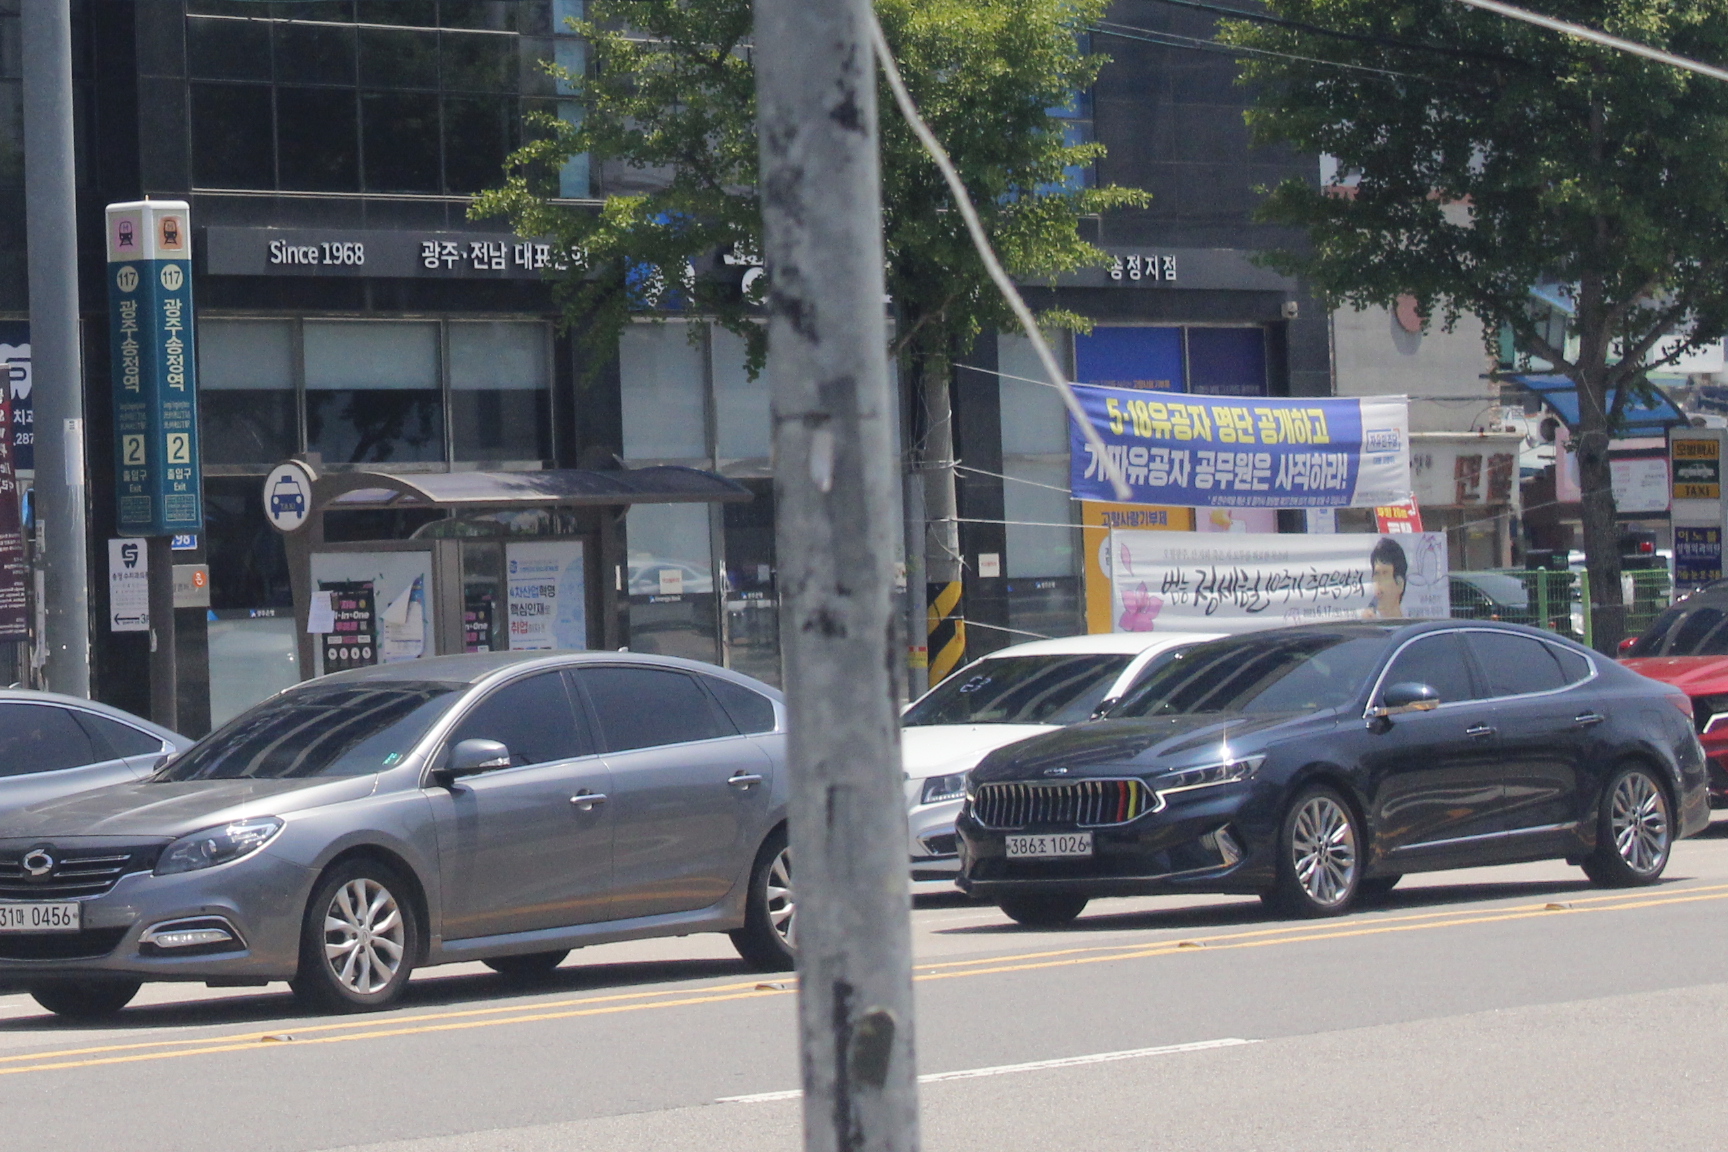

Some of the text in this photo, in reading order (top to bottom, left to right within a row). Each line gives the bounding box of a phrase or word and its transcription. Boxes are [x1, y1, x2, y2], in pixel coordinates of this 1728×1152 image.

[269, 240, 319, 265] Since
[322, 241, 365, 266] 1968
[118, 272, 137, 288] 117
[162, 270, 181, 286] 117
[119, 299, 140, 394] 광주송정역
[163, 298, 185, 393] 광주송정역
[1212, 406, 1256, 445] 명단
[1254, 406, 1330, 445] 공개하고
[128, 437, 141, 462] 2
[172, 436, 185, 461] 2
[123, 469, 148, 482] 출입구
[167, 467, 192, 480] 출입구
[1194, 448, 1272, 490] 공무원은
[1275, 453, 1349, 491] 사직하라!
[129, 483, 142, 493] Exit
[173, 482, 187, 491] Exit
[1685, 486, 1710, 497] TAXI
[1305, 566, 1366, 602] 추모음악회
[1010, 835, 1087, 855] 386조 1026
[0, 905, 72, 927] 31마 0456
